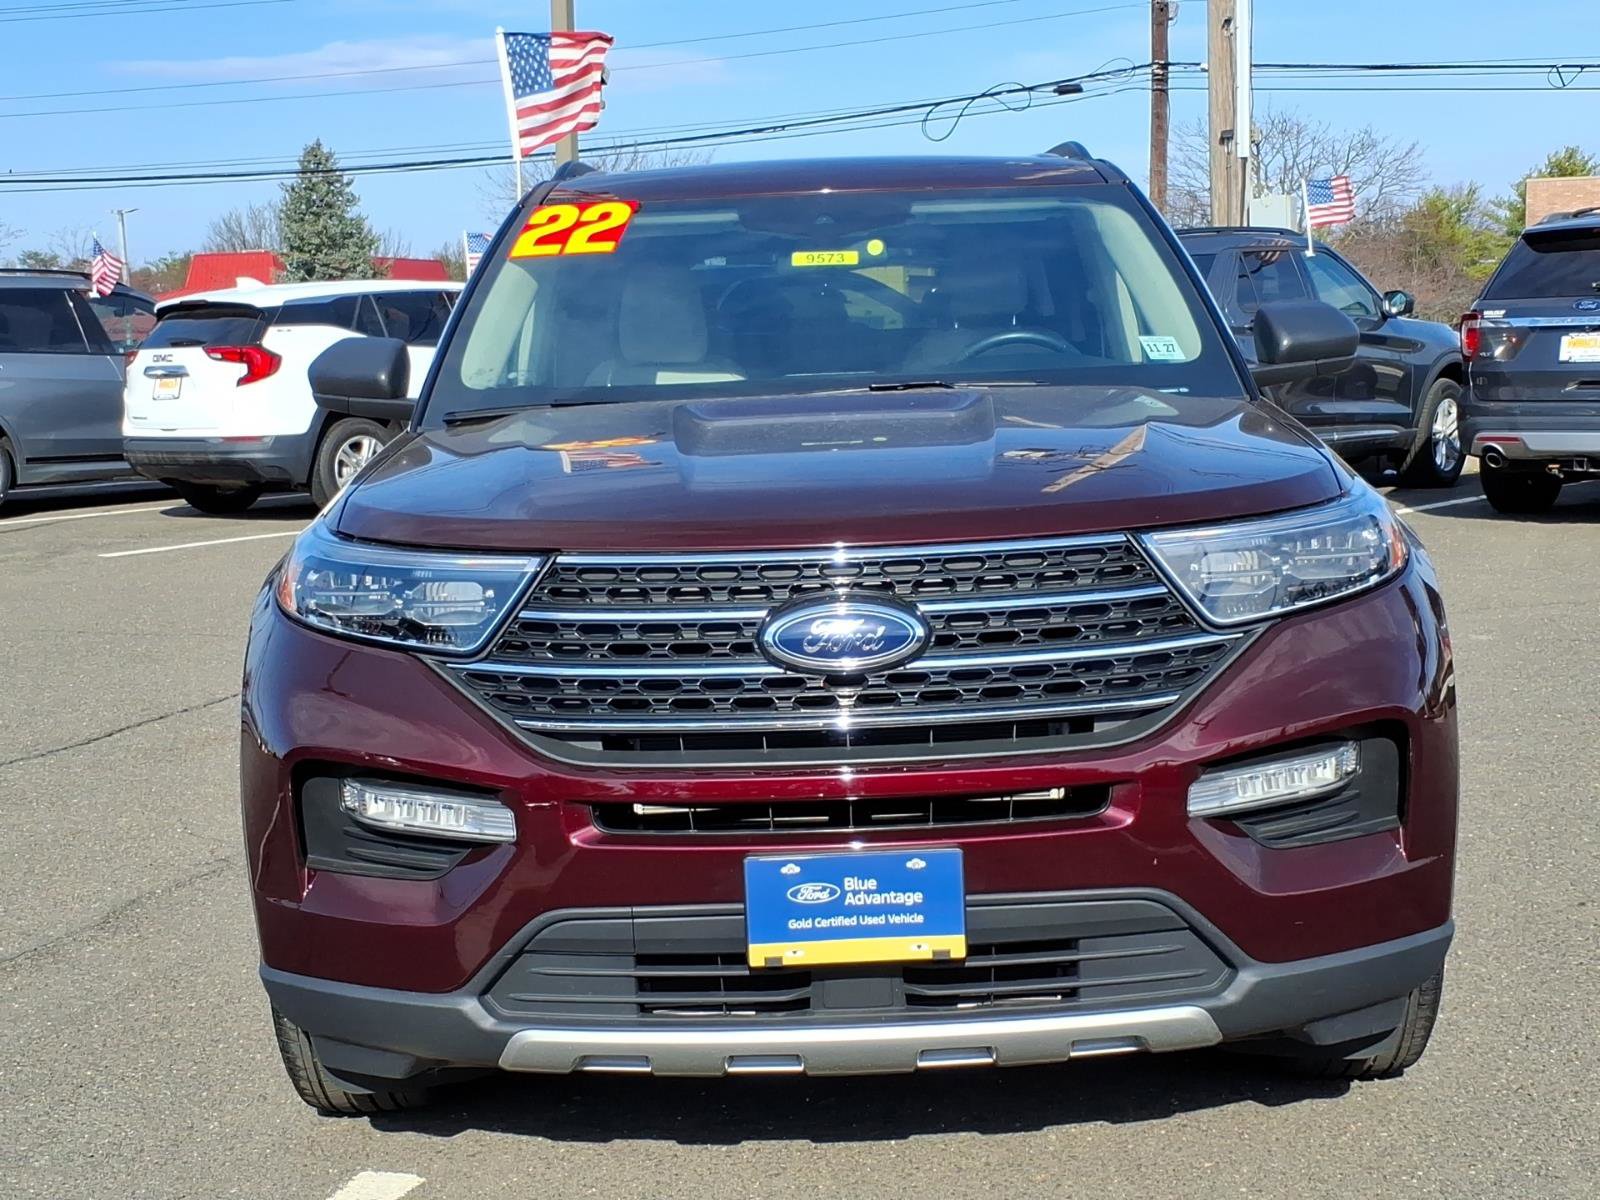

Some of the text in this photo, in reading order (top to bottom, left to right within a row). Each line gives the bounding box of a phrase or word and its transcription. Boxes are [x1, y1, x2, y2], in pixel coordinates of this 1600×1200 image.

[511, 202, 632, 257] 22
[806, 253, 846, 264] 9573
[153, 354, 173, 362] GMC
[803, 618, 886, 653] Ford
[844, 877, 877, 890] Blue
[796, 885, 831, 900] Ford
[844, 890, 924, 906] Advantage
[788, 913, 924, 929] Gold Certified Used Vehicle
